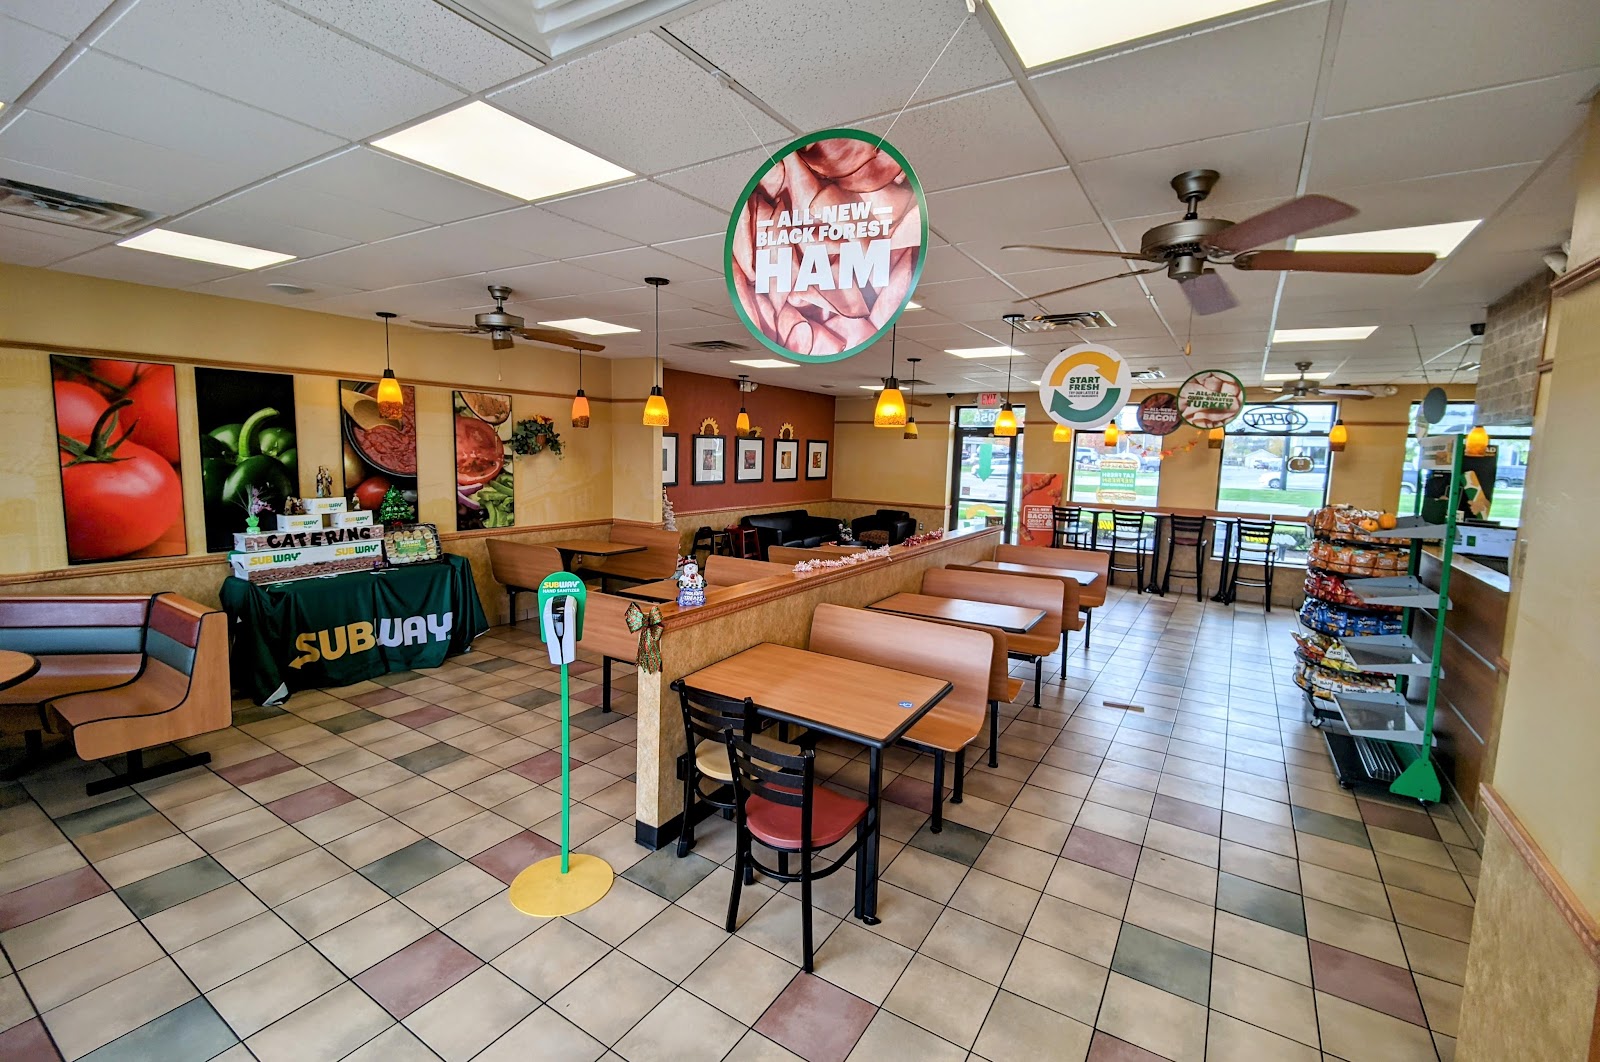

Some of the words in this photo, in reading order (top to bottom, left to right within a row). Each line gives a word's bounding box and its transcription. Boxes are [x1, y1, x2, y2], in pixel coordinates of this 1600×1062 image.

[777, 202, 872, 228] ALL-NEW
[757, 227, 816, 247] BLACK
[818, 219, 893, 242] FOREST
[755, 239, 891, 293] HAM
[981, 393, 997, 405] EXIT
[1187, 400, 1233, 410] TURKEY
[1143, 413, 1177, 422] BACON
[291, 519, 318, 527] SUBWAY
[267, 527, 371, 549] CATERING
[335, 544, 379, 557] SUBWAY
[249, 552, 301, 566] SUBWAY
[542, 580, 580, 589] SUBWAY
[288, 612, 453, 669] SUBWAY
